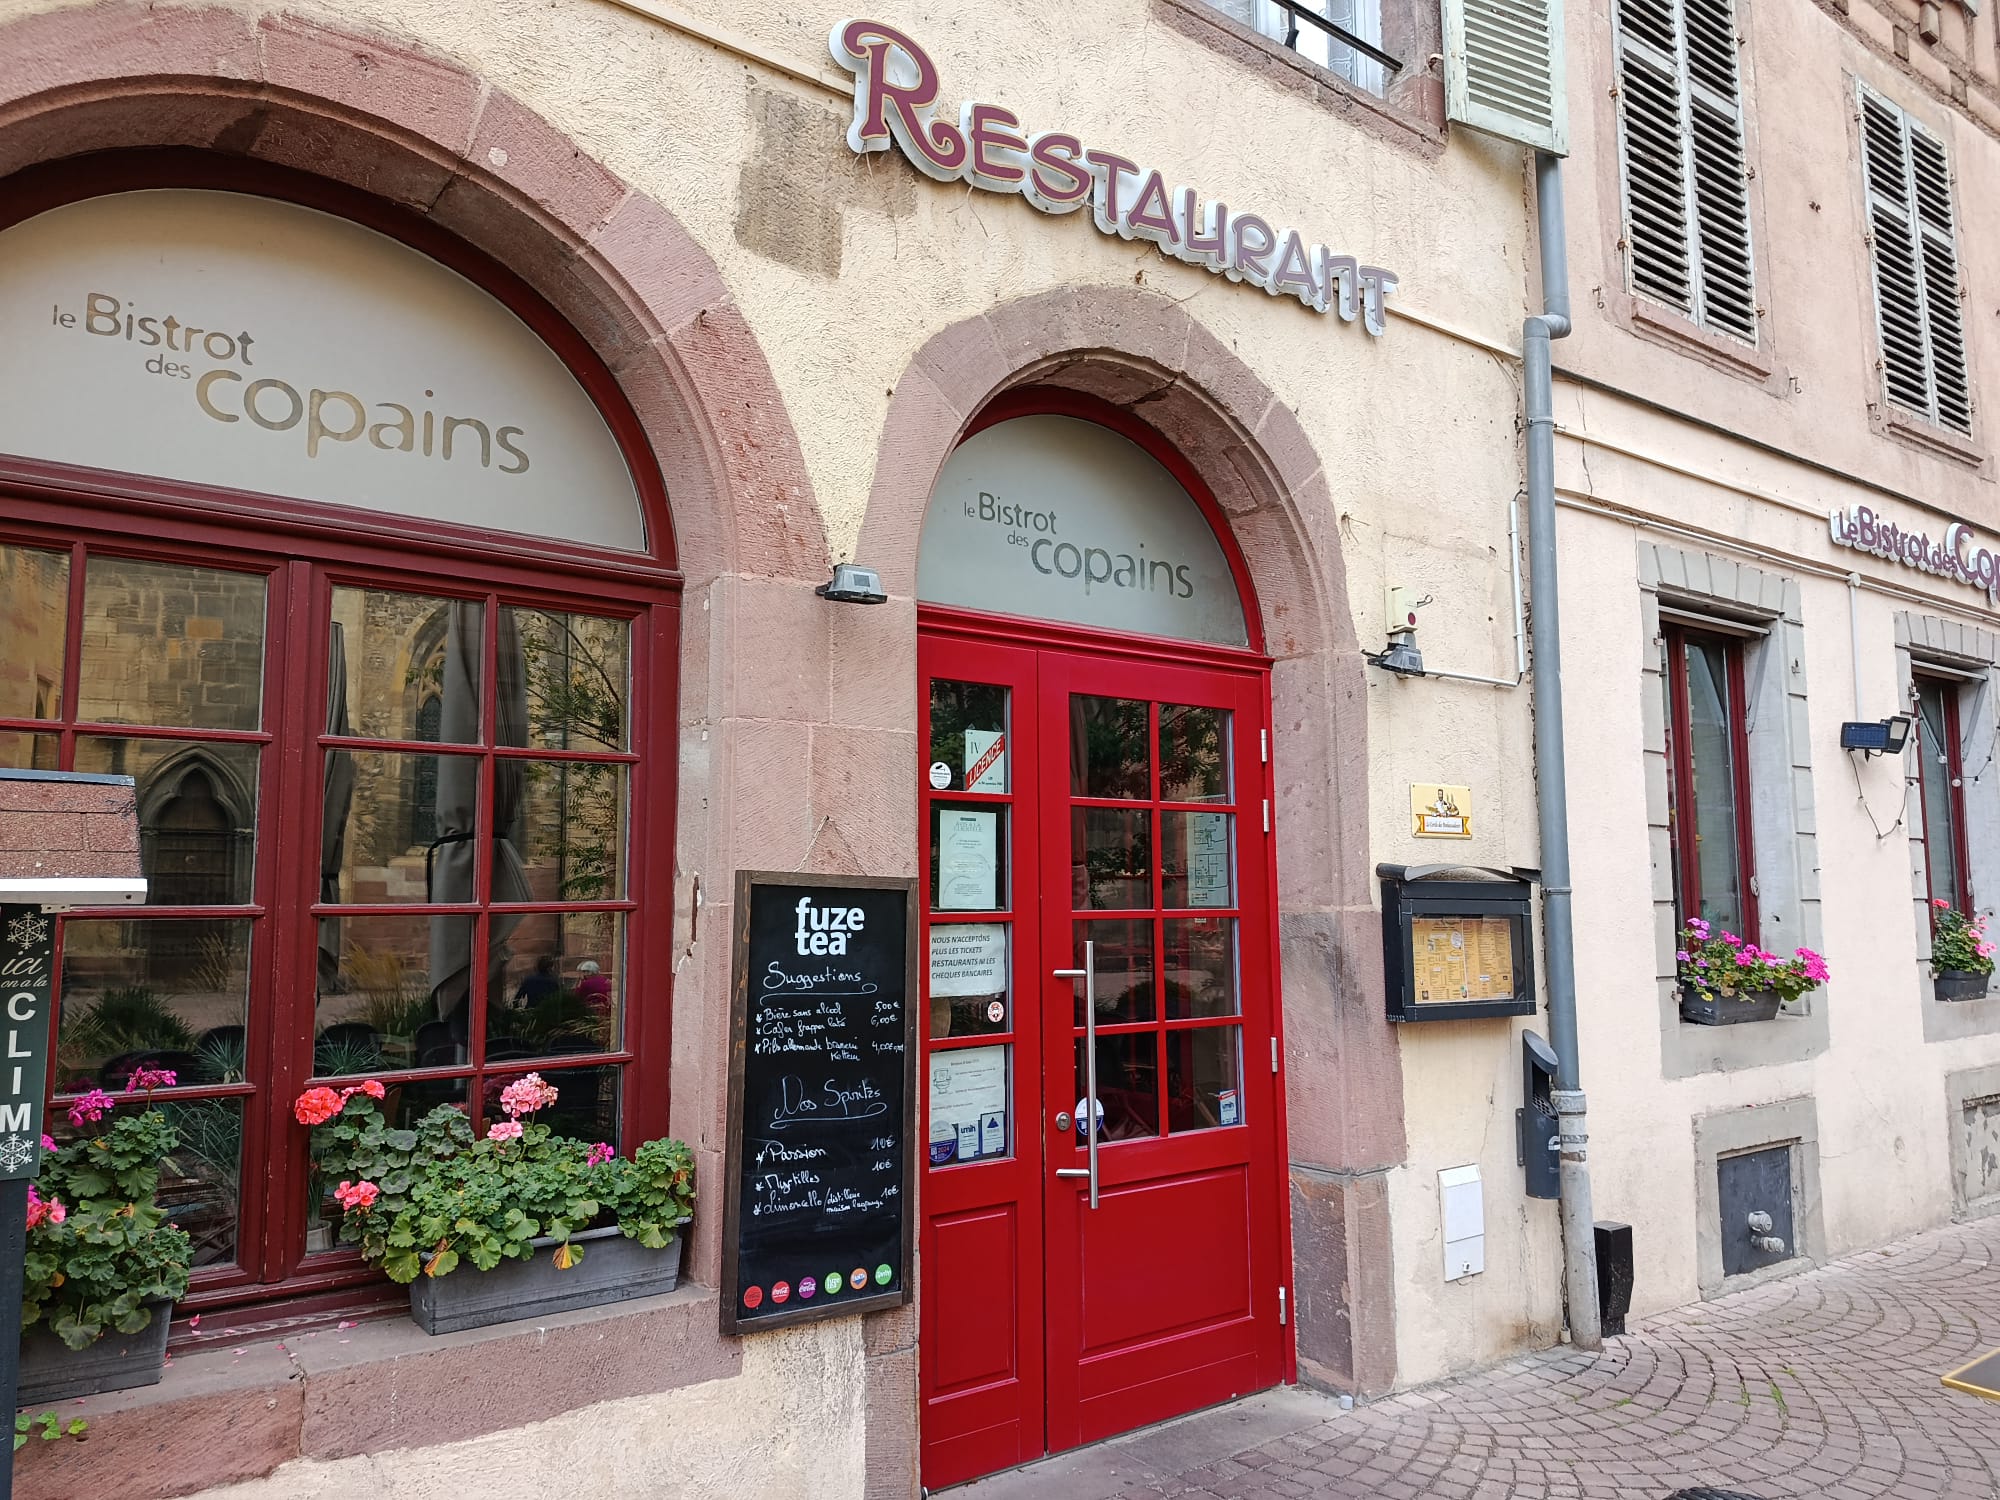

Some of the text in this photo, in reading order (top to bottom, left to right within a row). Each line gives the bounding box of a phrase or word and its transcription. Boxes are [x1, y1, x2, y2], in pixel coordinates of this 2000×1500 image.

[52, 292, 255, 366] le Bistrot
[145, 354, 192, 380] des
[963, 491, 1057, 535] le Bistrot
[1007, 530, 1029, 548] des
[1857, 504, 1931, 567] Bistrot
[1931, 542, 1957, 574] des
[1952, 524, 2000, 602] Co
[968, 737, 1002, 787] LICENCE
[795, 896, 866, 931] fuze
[794, 926, 852, 956] tea
[931, 936, 951, 944] NOUS
[931, 946, 983, 955] PLUS LES TICKETS
[1, 950, 50, 976] ici
[762, 960, 862, 990] Suggestions
[931, 958, 978, 967] RESTAURANTS
[986, 957, 996, 965] LES
[961, 969, 993, 978] BANCAIRES
[0, 973, 48, 988] on a la
[793, 1008, 812, 1018] sans
[815, 1001, 842, 1015] alcool
[765, 1140, 827, 1162] Passion
